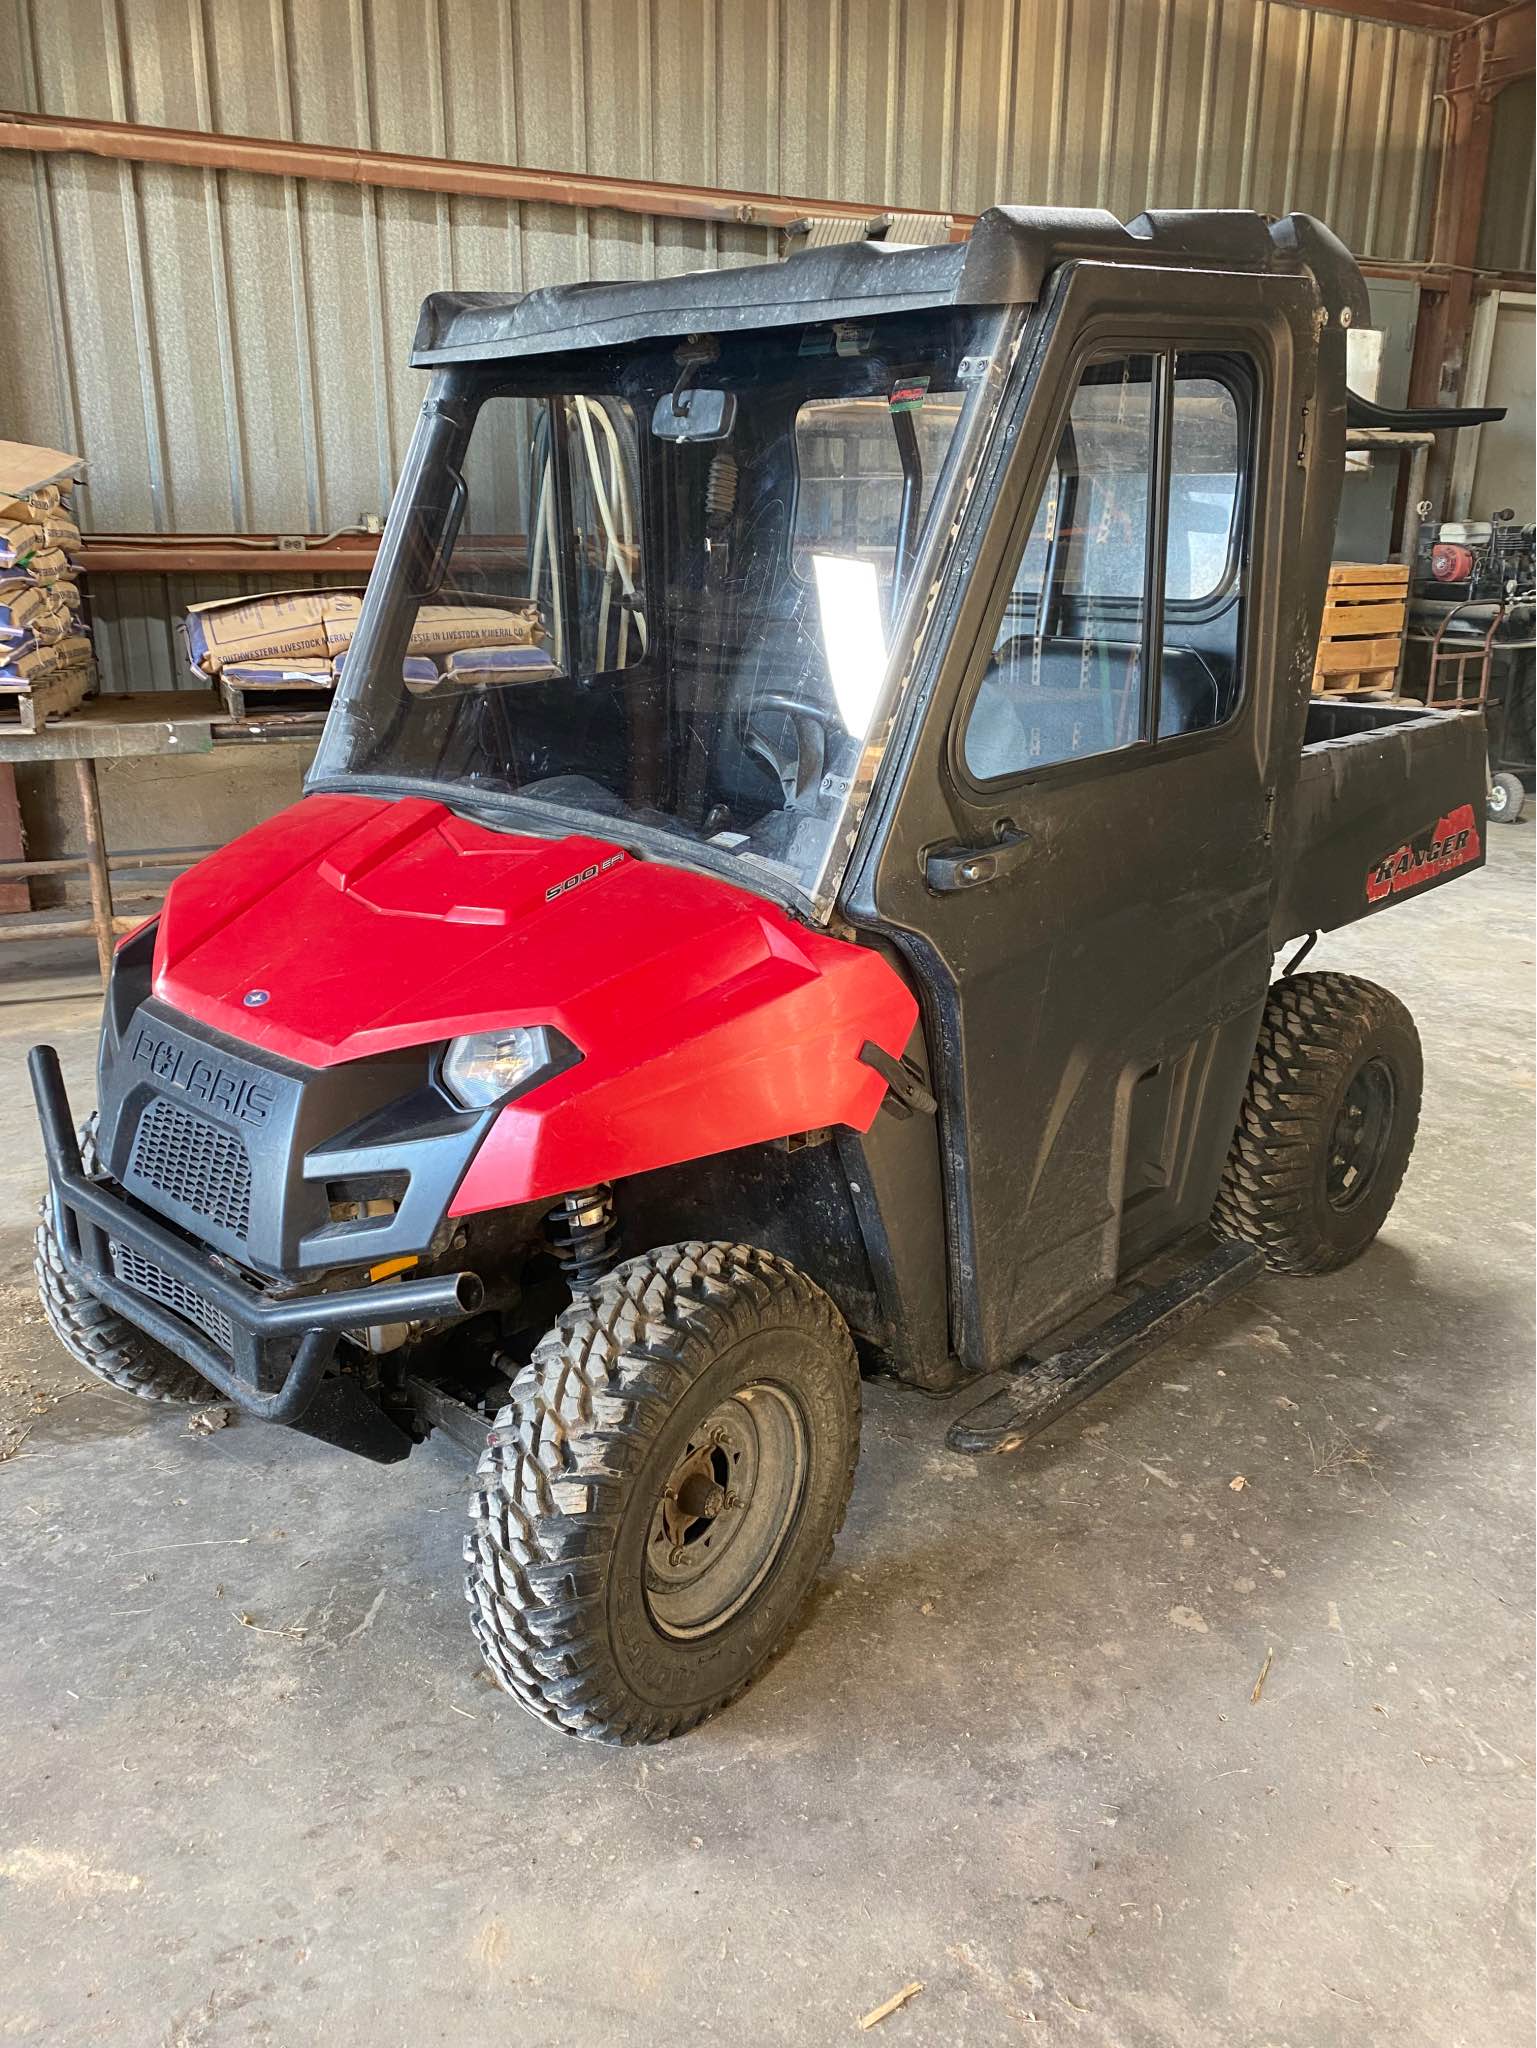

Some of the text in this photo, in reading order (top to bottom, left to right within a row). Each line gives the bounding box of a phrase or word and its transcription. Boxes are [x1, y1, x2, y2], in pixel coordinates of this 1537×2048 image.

[217, 645, 279, 664] SOUTHWESTERN
[280, 638, 320, 654] LIVESTOCK
[442, 630, 480, 640] LIVESTOCK
[1375, 828, 1471, 884] RANGER
[545, 864, 599, 902] 500
[132, 1030, 275, 1128] POLARIS
